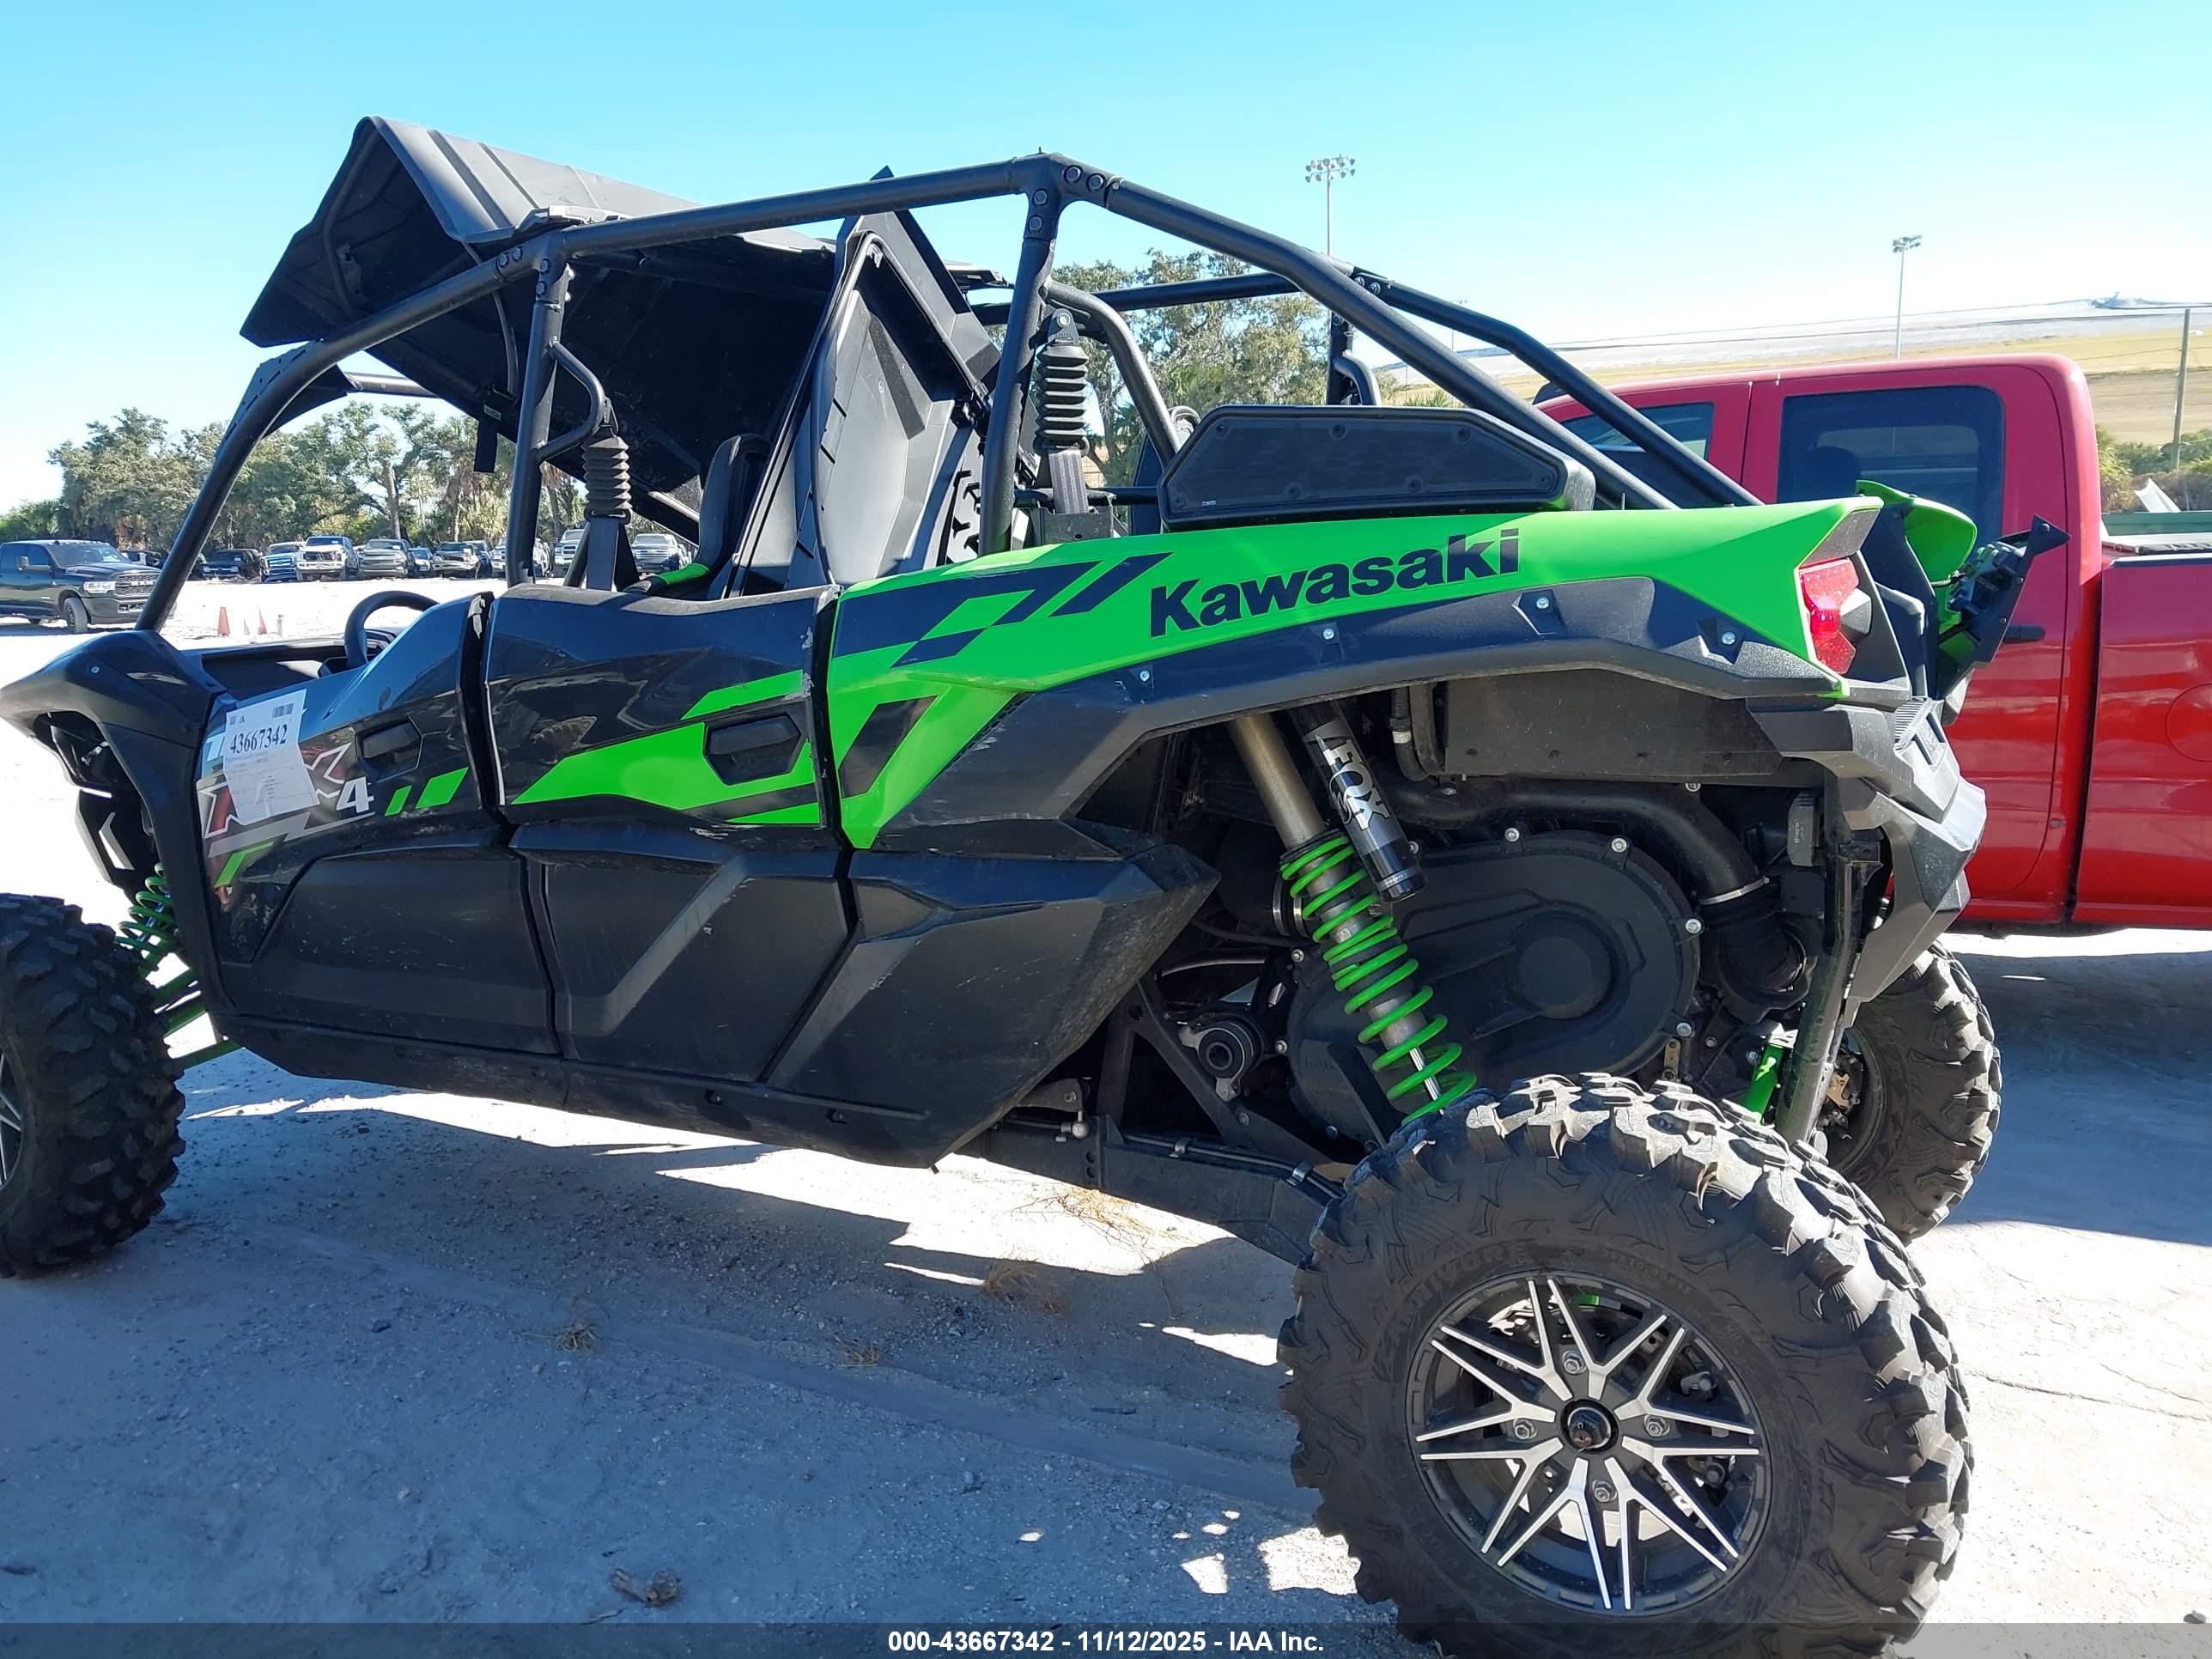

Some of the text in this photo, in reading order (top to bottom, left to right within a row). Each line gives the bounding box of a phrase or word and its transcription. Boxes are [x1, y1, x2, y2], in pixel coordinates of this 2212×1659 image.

[1150, 528, 1519, 638] Kawasaki
[230, 724, 288, 754] 43667342
[1323, 738, 1391, 830] FOX
